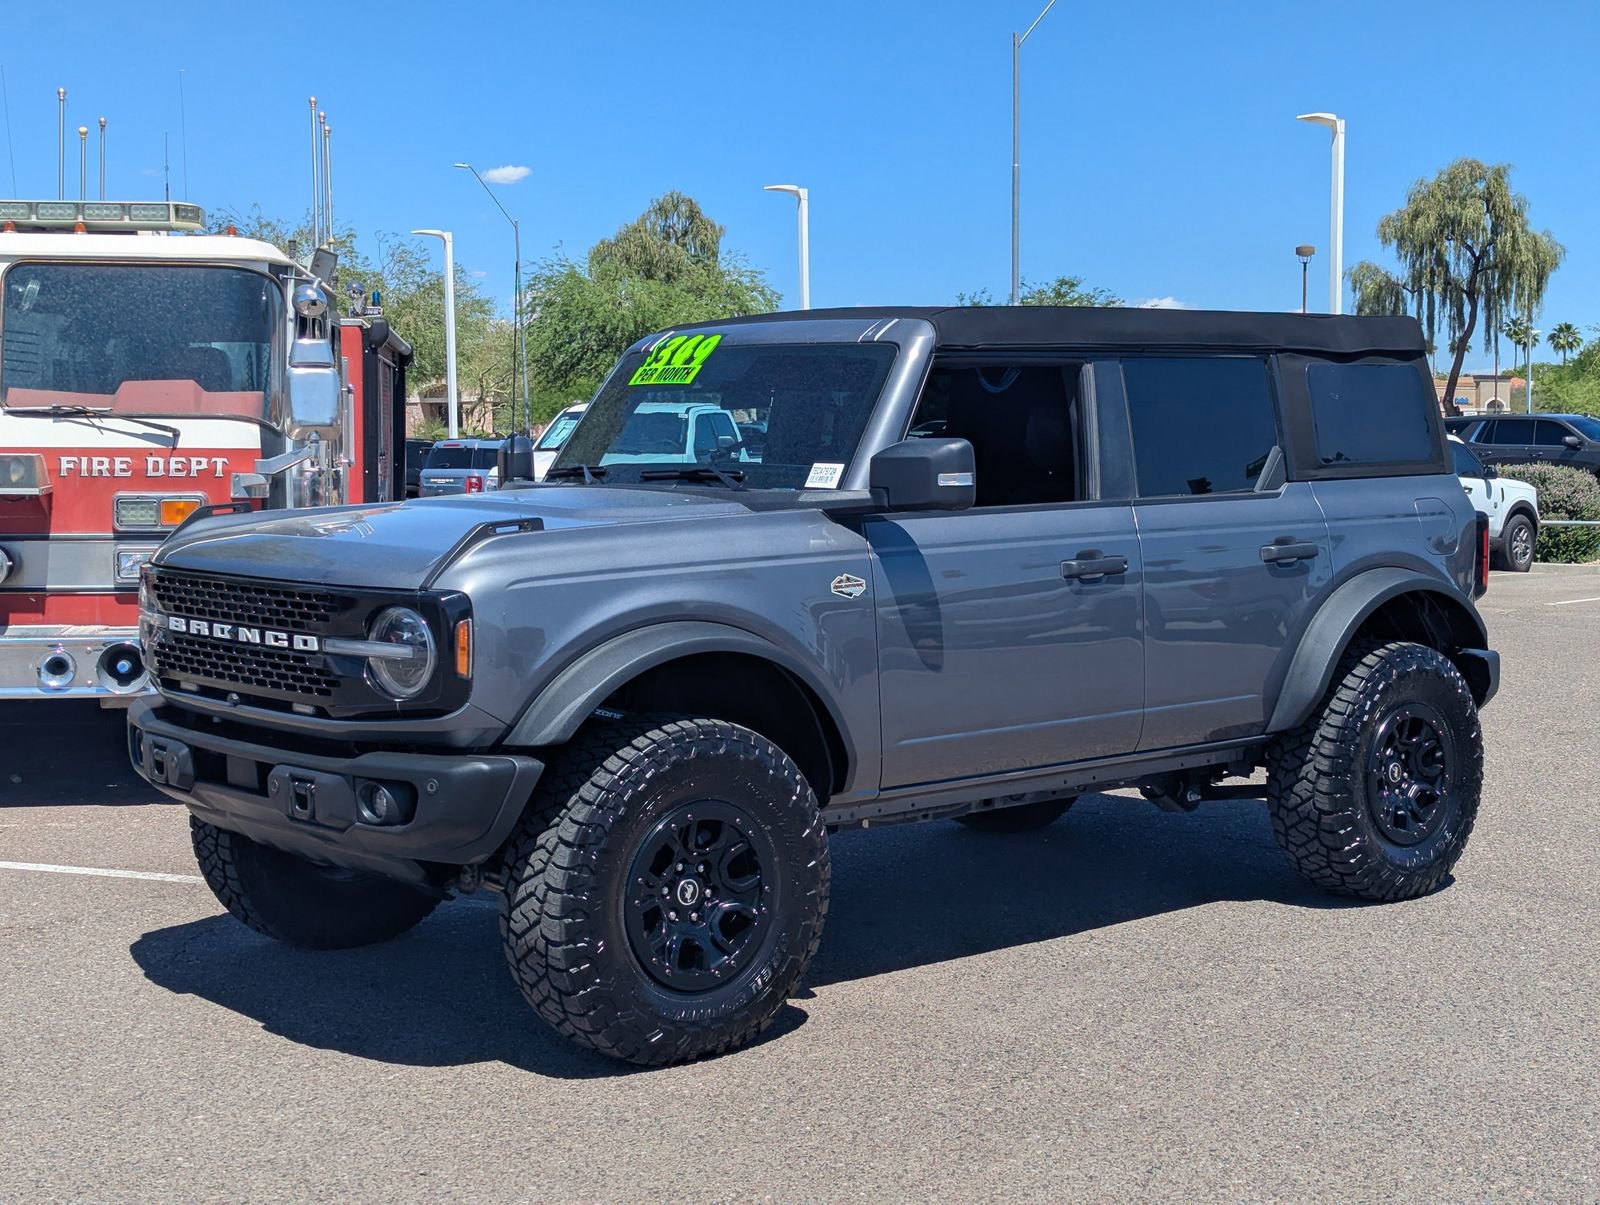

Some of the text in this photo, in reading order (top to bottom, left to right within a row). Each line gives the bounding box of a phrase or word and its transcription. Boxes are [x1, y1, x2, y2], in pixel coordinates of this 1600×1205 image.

[633, 366, 696, 382] PER MONTH
[58, 456, 229, 477] FIRE DEPT
[168, 615, 319, 651] BRONCO
